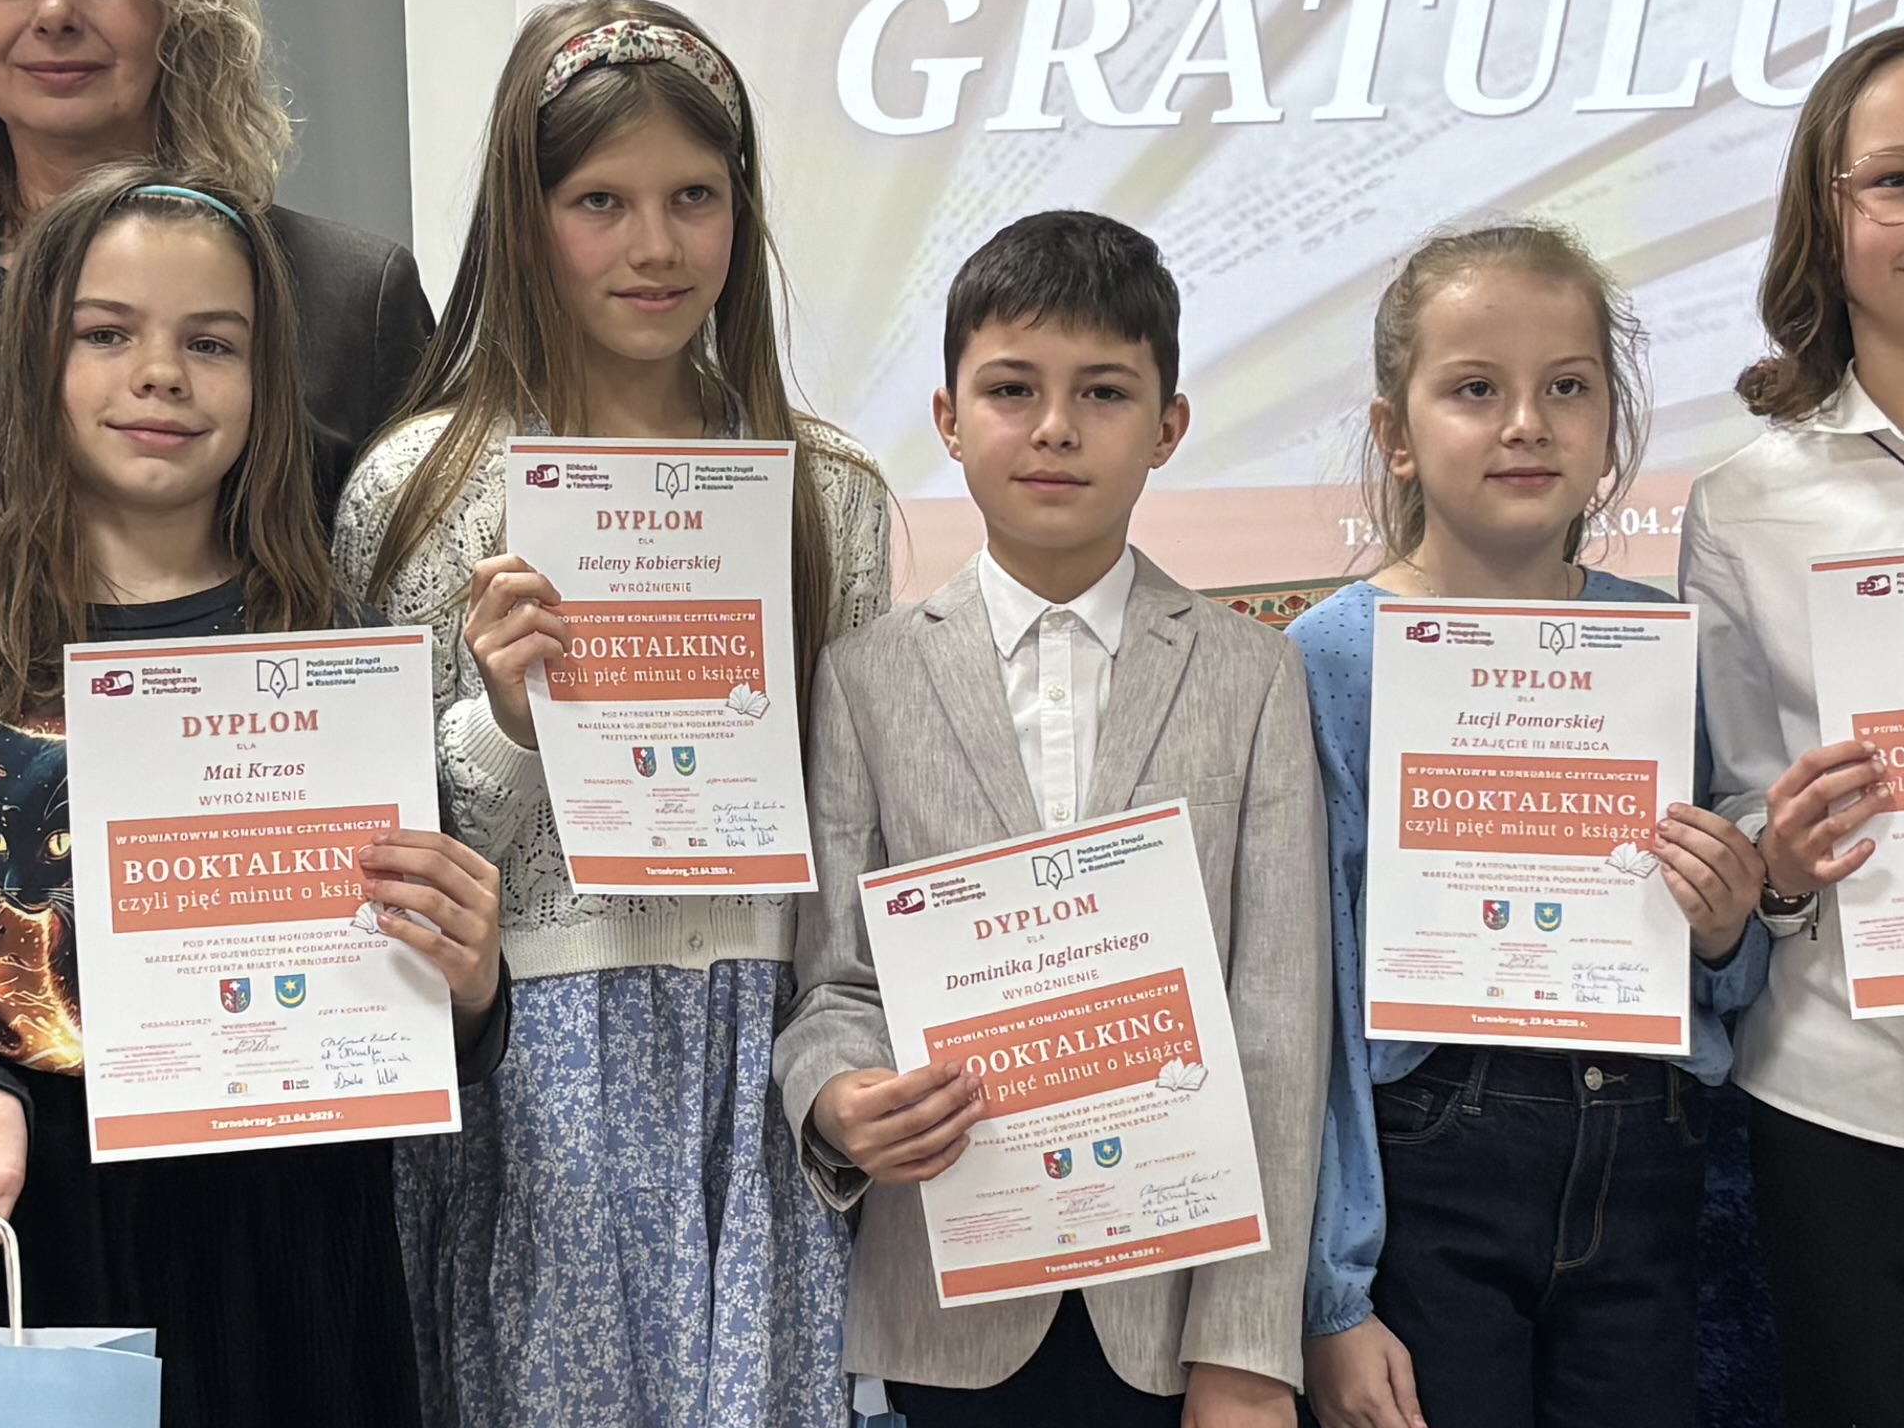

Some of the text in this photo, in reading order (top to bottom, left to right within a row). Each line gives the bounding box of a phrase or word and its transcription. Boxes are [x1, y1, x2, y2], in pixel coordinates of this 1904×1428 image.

[597, 511, 702, 530] DYPLOM
[579, 556, 720, 573] Heleny Kobierskiej
[572, 636, 754, 658] OOKTALKING,
[552, 666, 759, 686] czyli pięć minut o książce
[1472, 669, 1591, 690] DYPLOM
[182, 710, 318, 737] DYPLOM
[204, 763, 304, 780] Mai Krzos
[199, 790, 305, 805] WYRÓŻNIENIE
[1413, 788, 1645, 818] BOOKTALKING,
[1406, 818, 1649, 842] czyli pięć minut o książce
[124, 847, 354, 883] BOOKTALKIN
[119, 879, 363, 914] czyli pięć minut o ksią
[974, 894, 1098, 940] DYPLOM
[947, 933, 1148, 990] Dominika Jaglarskiego
[967, 1011, 1183, 1076] OOKTALKING,
[998, 1041, 1192, 1101] pięć minut o książce
